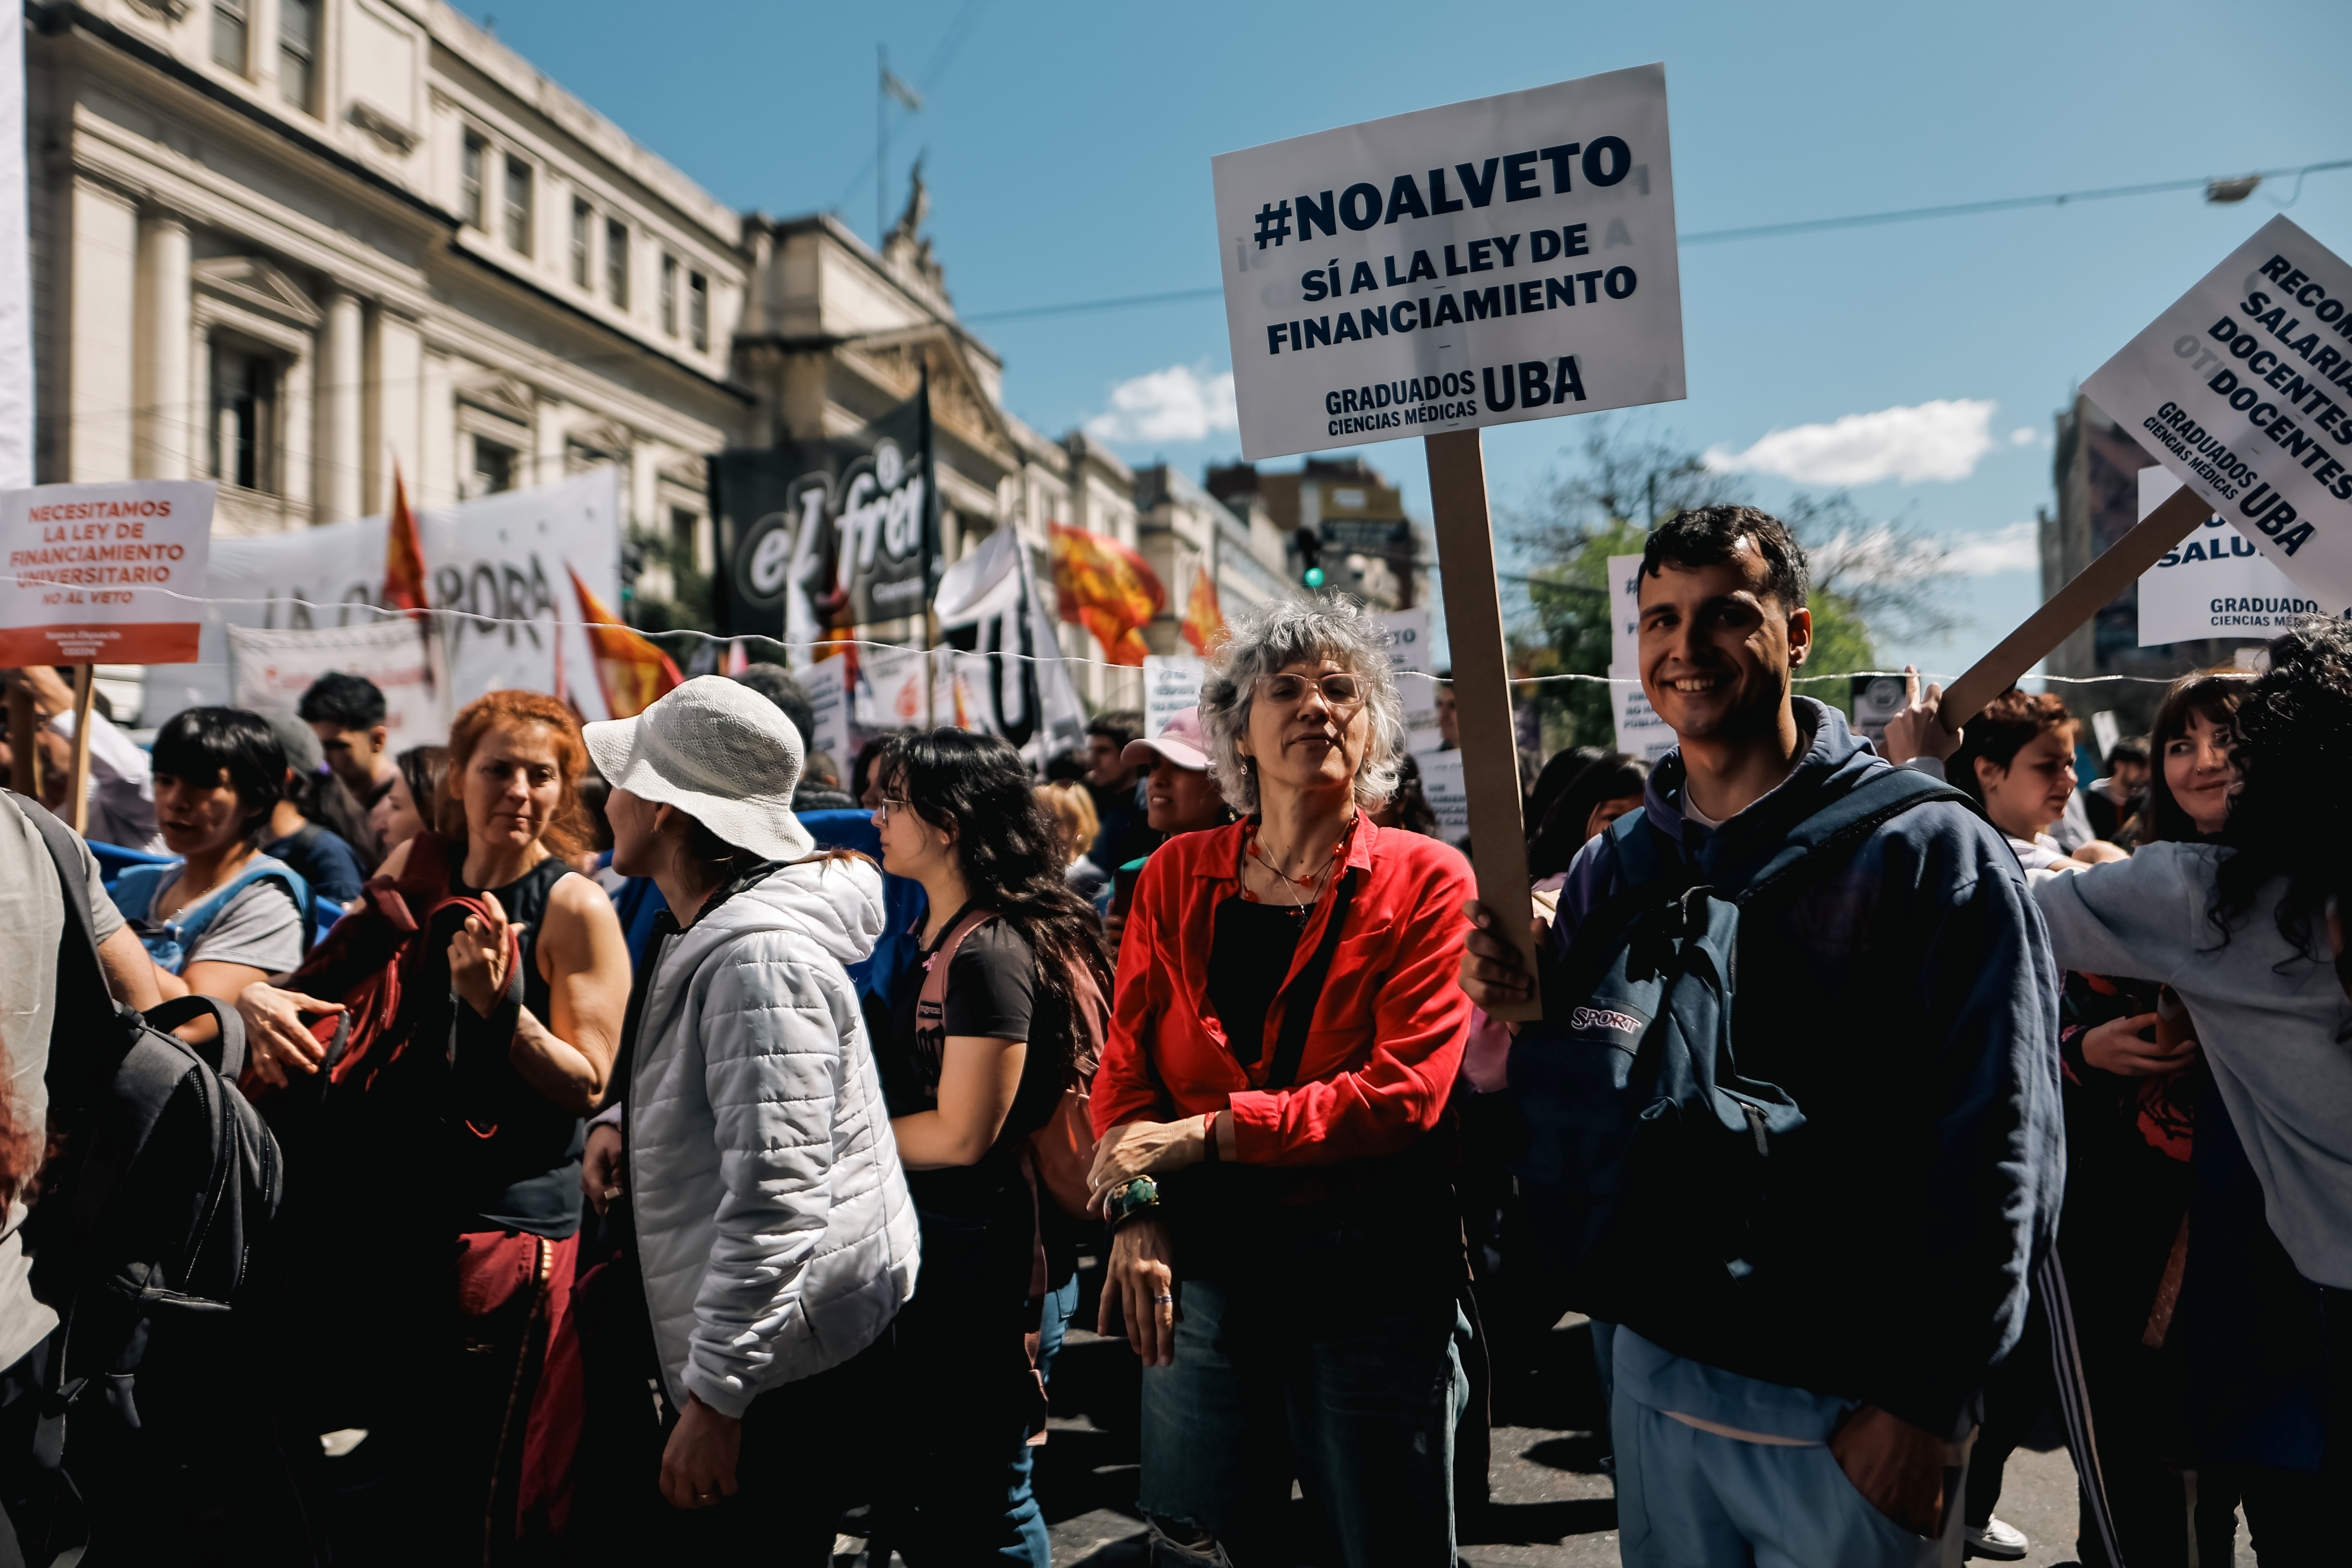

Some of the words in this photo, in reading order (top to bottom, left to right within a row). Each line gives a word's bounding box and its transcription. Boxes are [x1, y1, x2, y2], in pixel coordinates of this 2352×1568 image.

[1254, 135, 1631, 250] #NOALVETO
[1301, 258, 1342, 302] SÍ
[1349, 260, 1379, 295] A
[1384, 249, 1438, 288] LA
[1443, 233, 1521, 277] LEY
[1529, 222, 1589, 264] DE
[1266, 265, 1637, 355] FINANCIAMIENTO
[1325, 370, 1476, 415] GRADUADOS
[1482, 355, 1587, 413] UBA
[2207, 315, 2352, 445] DOCENTES
[1328, 410, 1401, 437] CIENCIAS
[1403, 399, 1477, 425] MÉDICAS
[2207, 368, 2352, 500] DOCENTES
[2143, 417, 2193, 462] CIENCIAS
[2187, 456, 2239, 500] MÉDICAS
[2157, 402, 2258, 488] GRADUADOS
[2239, 481, 2315, 558] UBA
[29, 500, 171, 523] NECESITAMOS
[44, 526, 66, 543] LA
[72, 523, 110, 541] LEY
[115, 522, 144, 539] DE
[10, 543, 185, 567] FINANCIAMIENTO
[2157, 535, 2265, 567] SALU
[16, 566, 171, 589] UNIVERSITARIO
[43, 592, 61, 605] NO
[65, 592, 84, 604] AL
[90, 591, 133, 604] VETO
[2210, 597, 2327, 614] GRADUADO
[2211, 615, 2270, 626] CIENCIAS
[1571, 1006, 1642, 1034] SPORT
